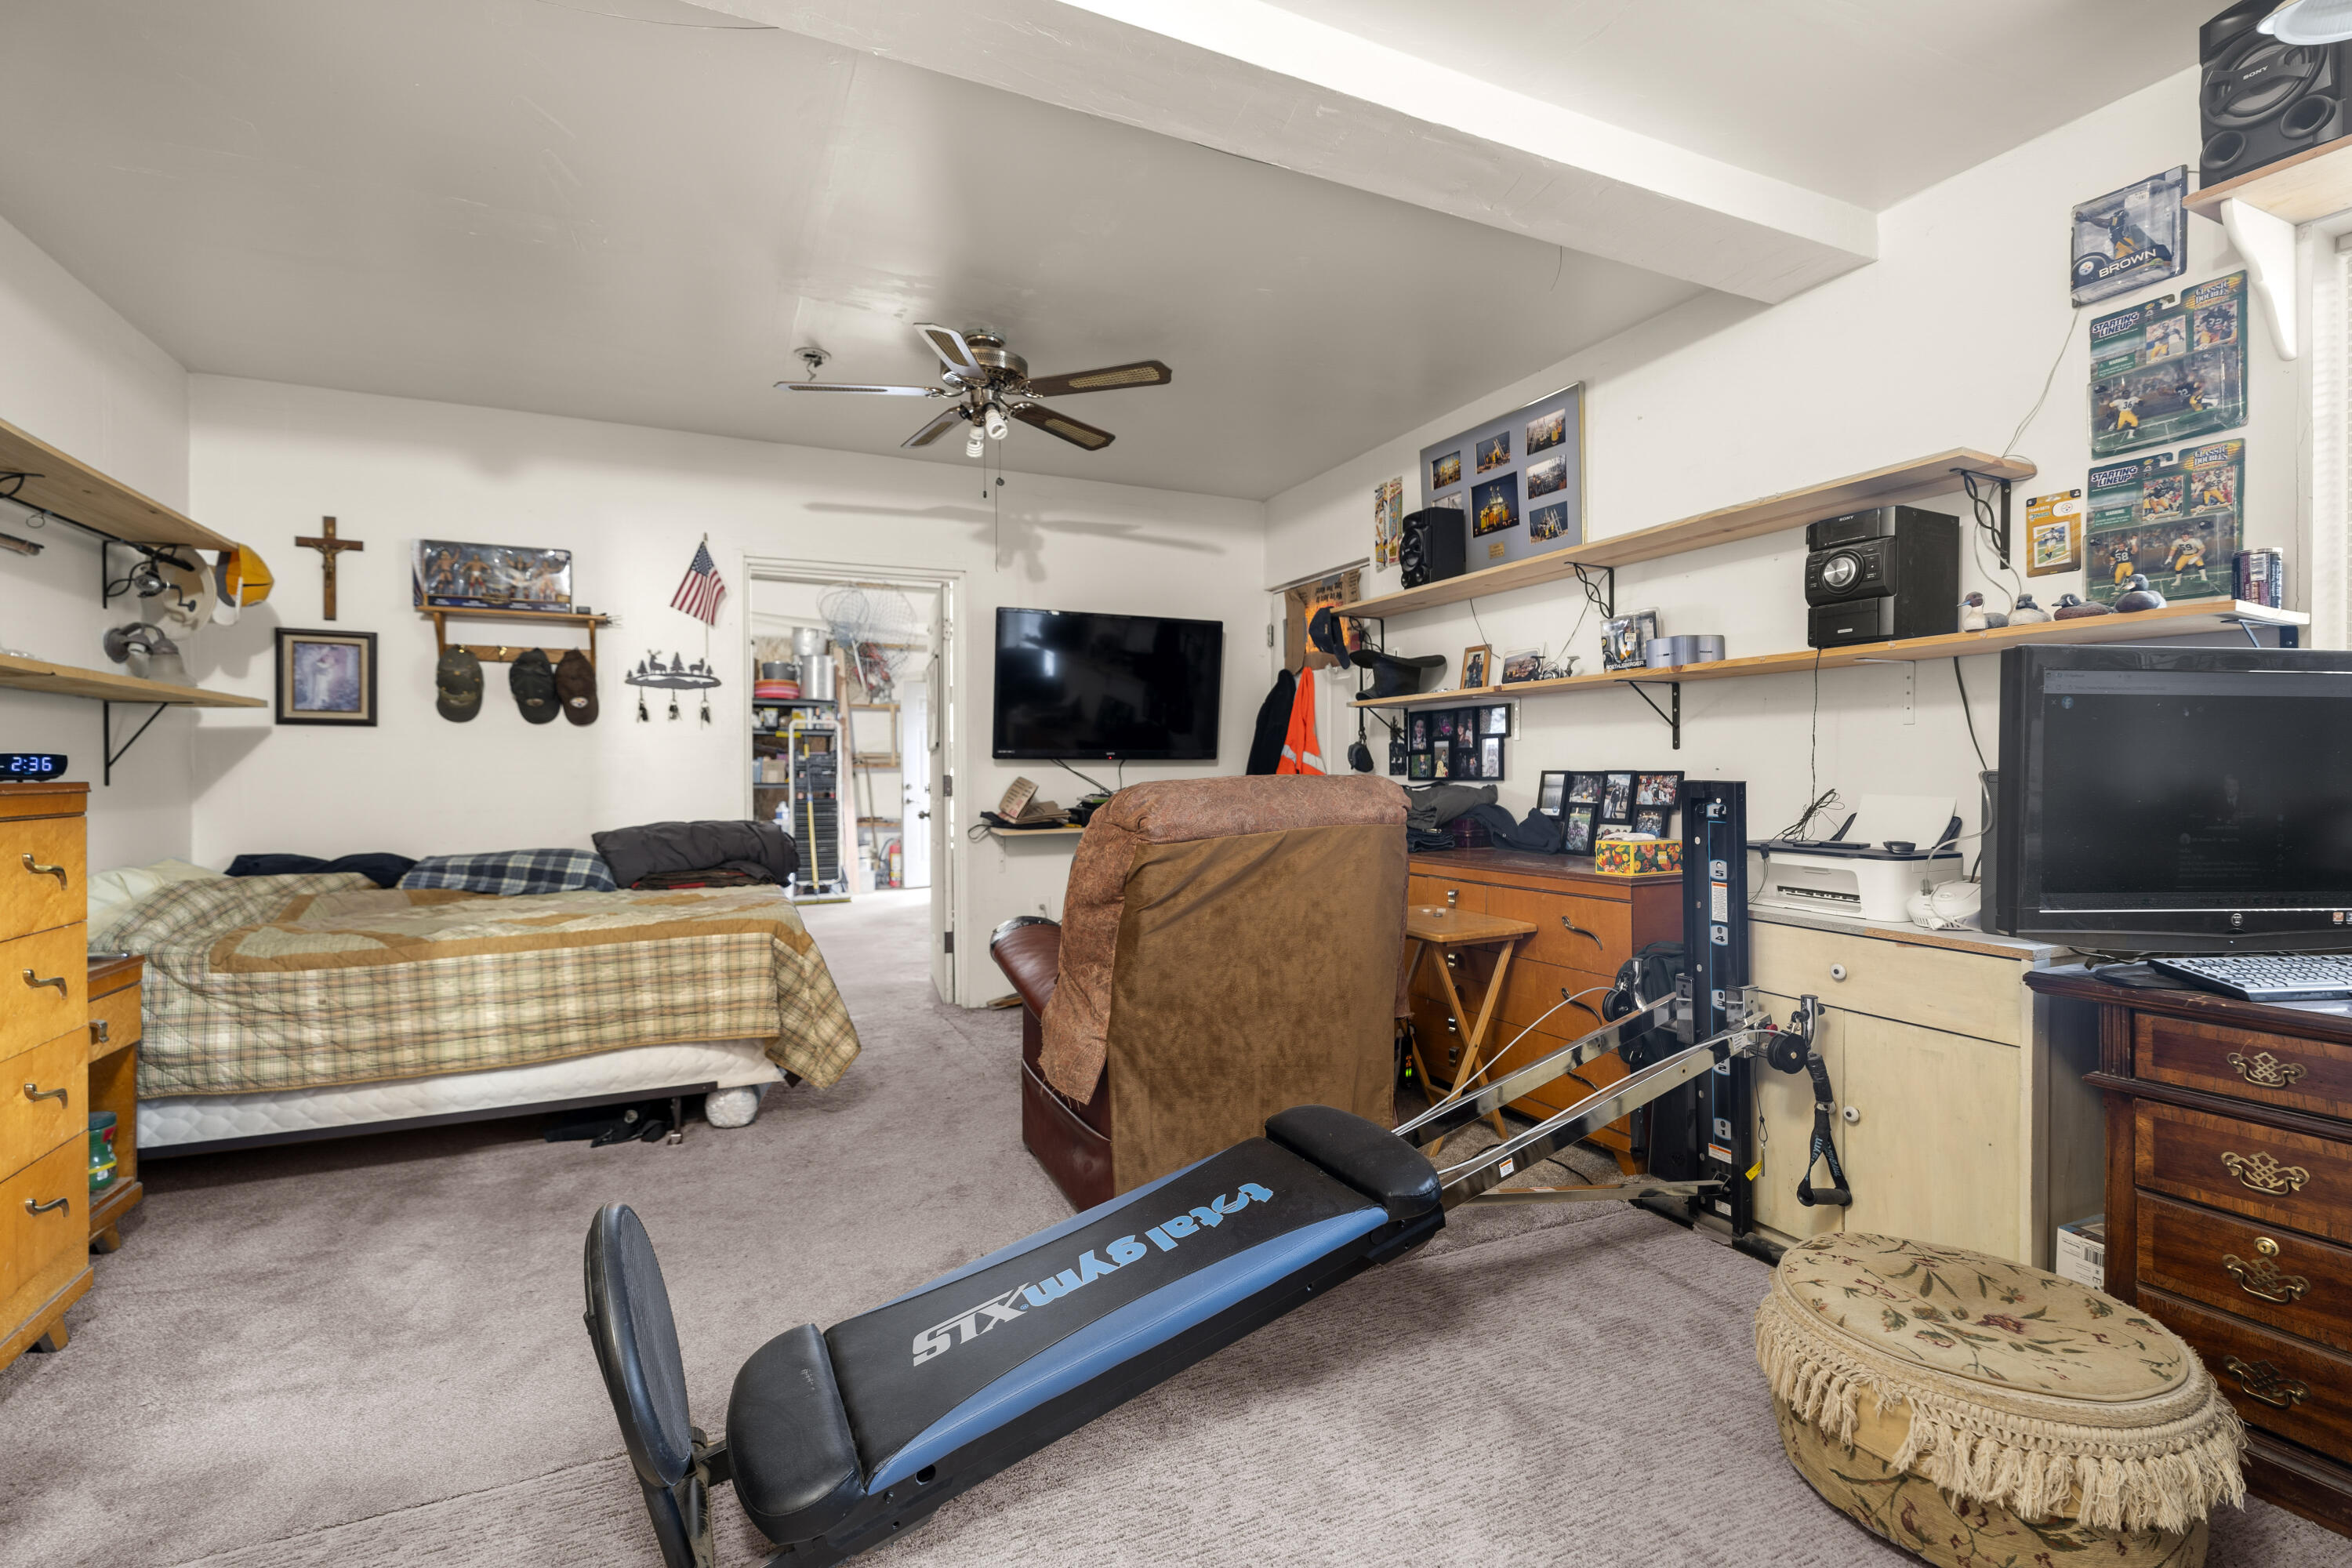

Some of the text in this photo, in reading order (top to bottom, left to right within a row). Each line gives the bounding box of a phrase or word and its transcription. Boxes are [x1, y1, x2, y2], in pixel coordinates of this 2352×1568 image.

[2243, 65, 2269, 81] SONY
[2099, 249, 2156, 278] BROWN
[2195, 281, 2228, 296] CLASSIC
[2092, 311, 2140, 333] STARTING
[2100, 321, 2133, 338] LINEUP
[2122, 401, 2132, 409] 36
[2194, 445, 2227, 458] CLASSIC
[2194, 453, 2228, 466] DOUBLES
[2091, 466, 2138, 482] STARTING
[2097, 474, 2132, 488] LINEUP
[2114, 552, 2129, 562] 58
[11, 757, 53, 771] 2:36
[1718, 1064, 1727, 1073] 2
[913, 1182, 1274, 1367] total gym XLS
